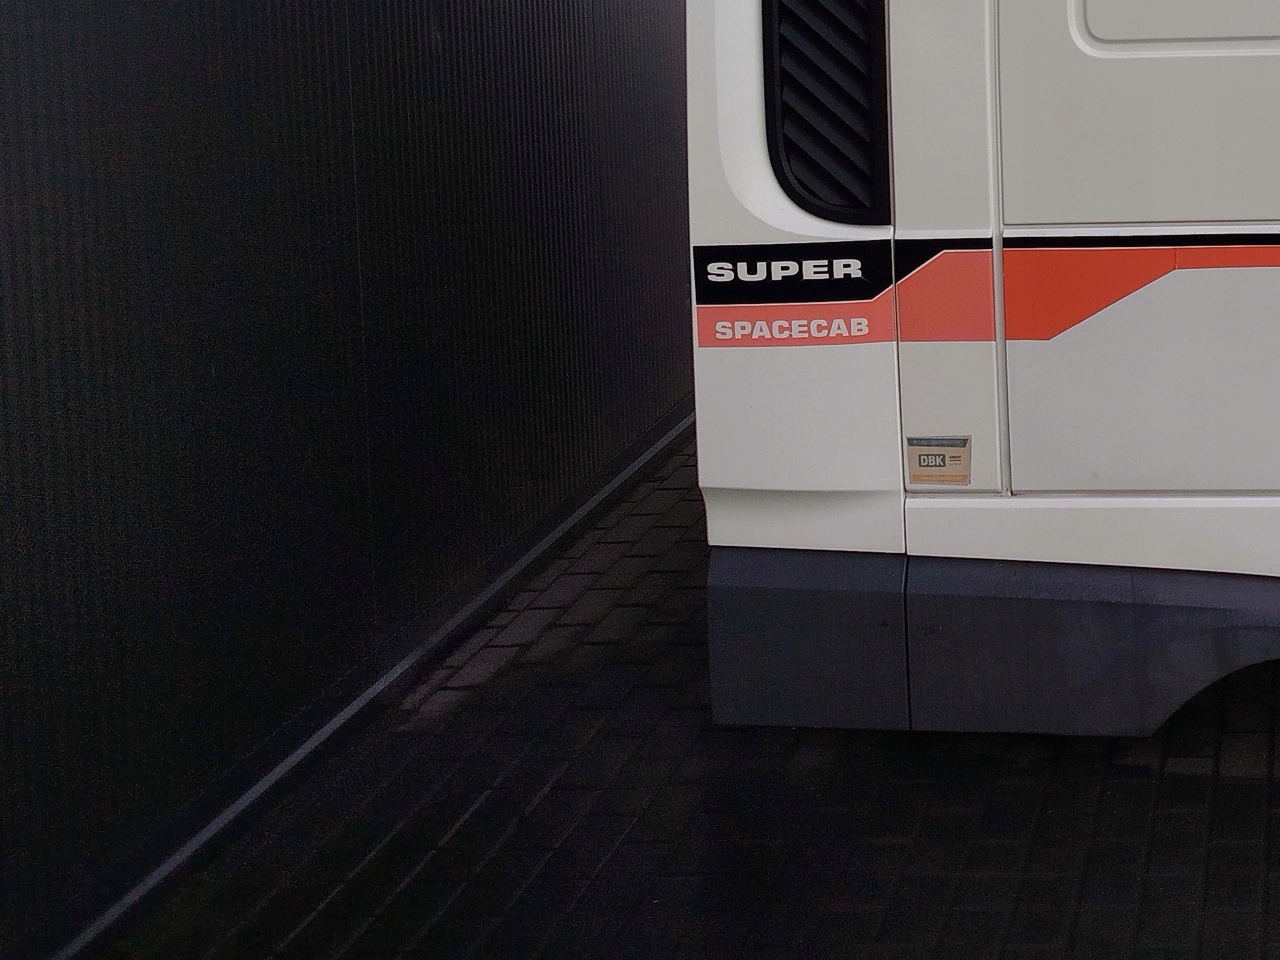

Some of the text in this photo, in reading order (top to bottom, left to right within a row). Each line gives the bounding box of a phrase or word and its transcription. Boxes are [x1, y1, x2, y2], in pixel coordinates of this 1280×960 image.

[707, 259, 862, 282] SUPER
[715, 317, 869, 339] SPACECAB
[920, 455, 944, 466] DBK
